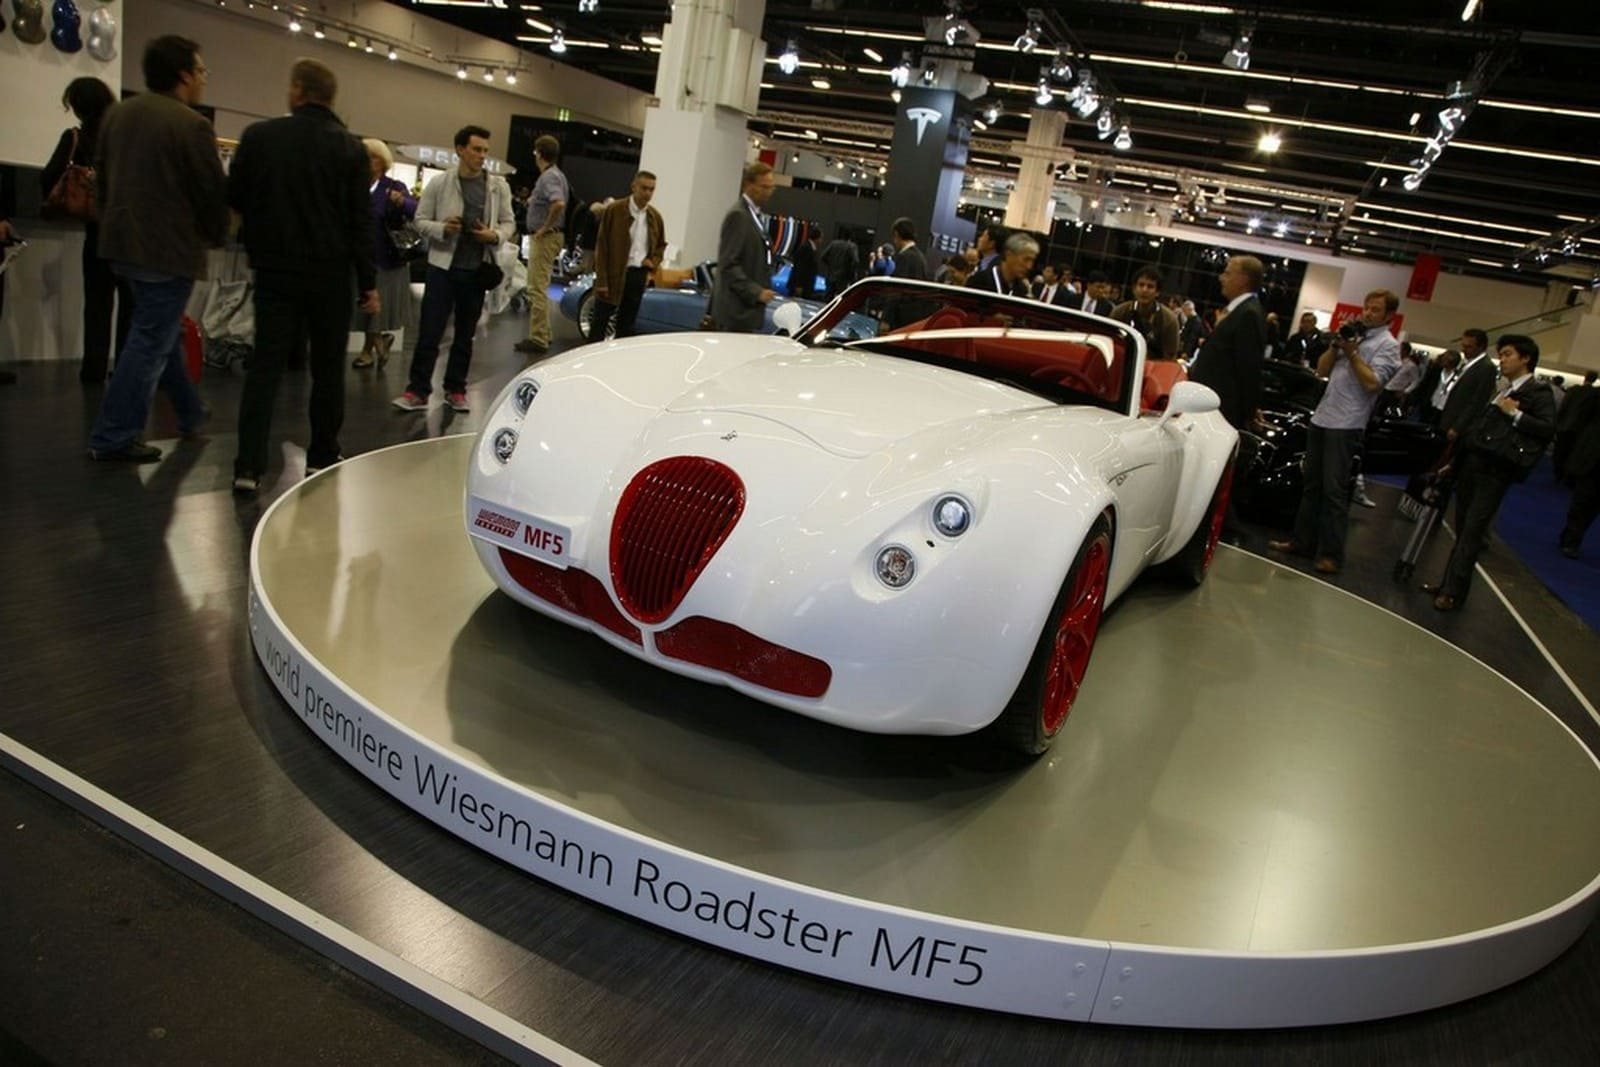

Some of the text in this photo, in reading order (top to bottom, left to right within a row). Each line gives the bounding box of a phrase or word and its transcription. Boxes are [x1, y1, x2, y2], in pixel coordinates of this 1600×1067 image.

[931, 232, 975, 256] TESL
[524, 524, 564, 555] MF5
[265, 637, 988, 986] world premiere Wiesmann Roadster MF5
